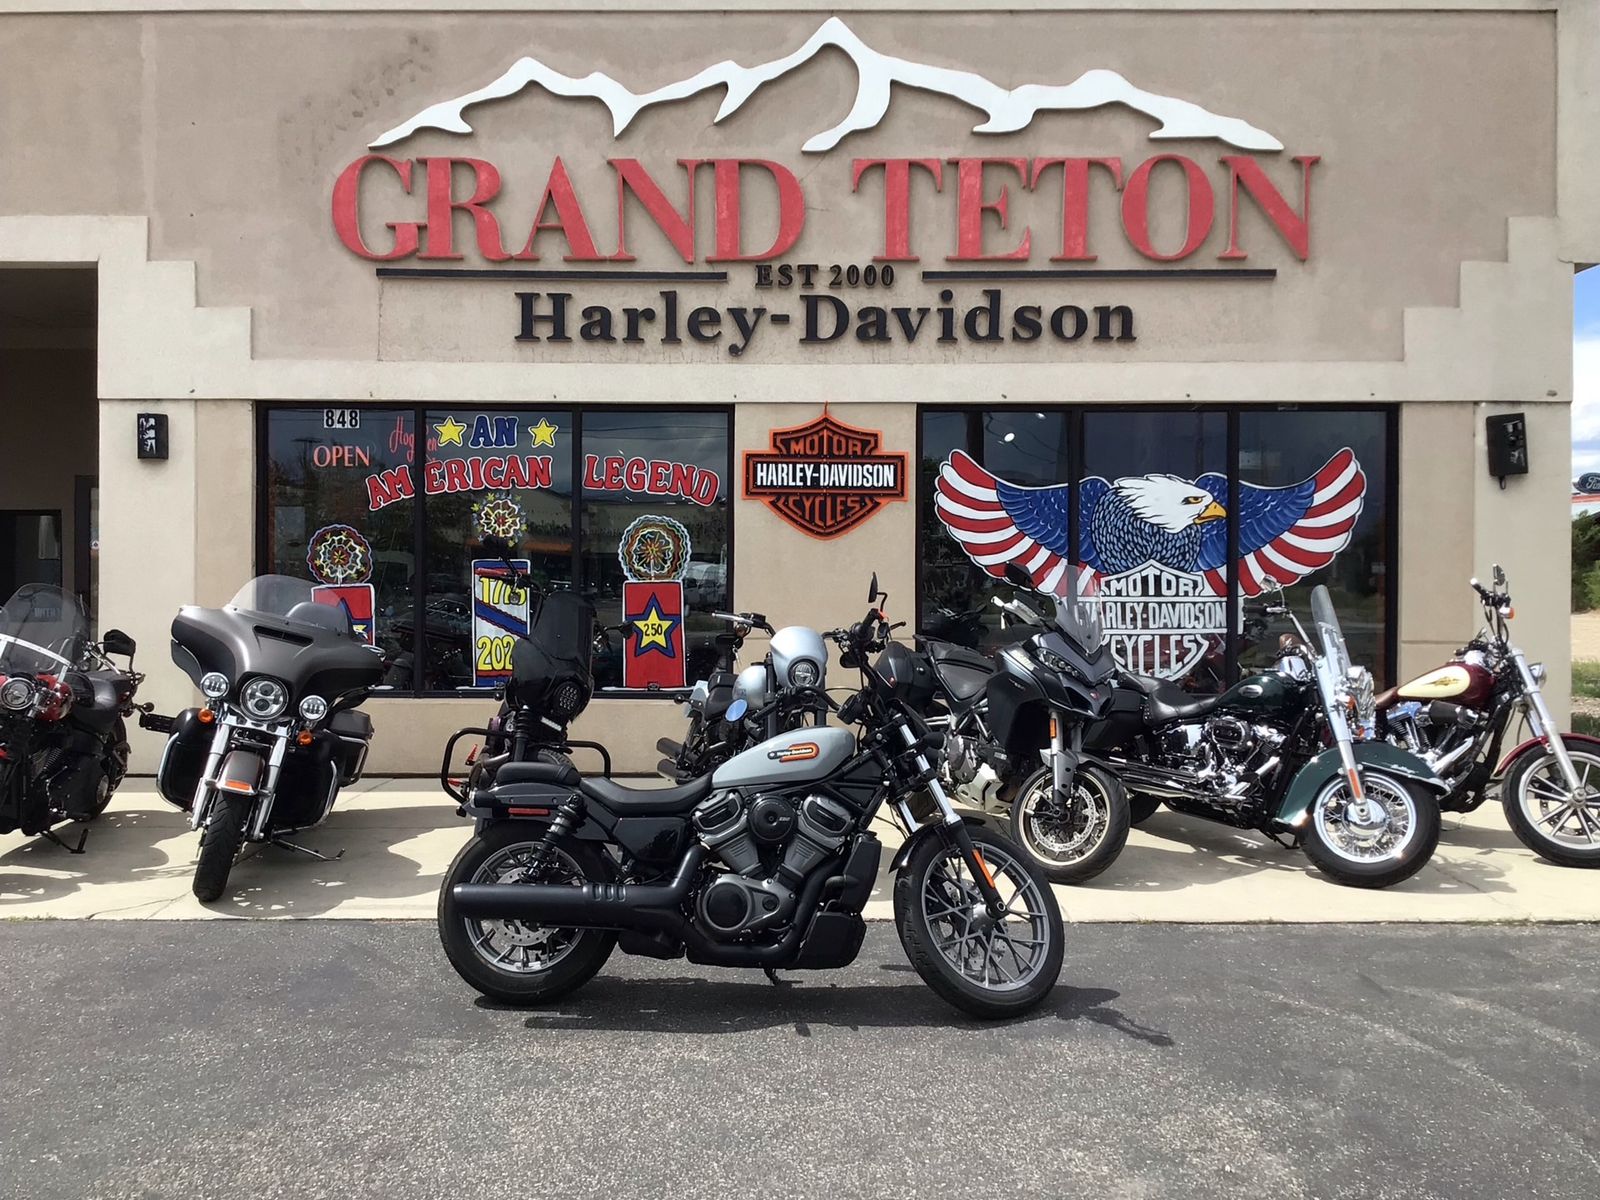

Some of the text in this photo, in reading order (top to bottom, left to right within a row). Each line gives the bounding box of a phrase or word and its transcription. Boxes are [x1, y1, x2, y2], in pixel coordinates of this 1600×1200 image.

[331, 153, 1320, 264] GRAND TETON
[755, 264, 895, 289] EST 2000
[514, 289, 1136, 357] Harley-Davidson
[325, 409, 359, 428] 848
[468, 414, 519, 449] AN
[313, 446, 370, 467] OPEN
[790, 430, 862, 455] MOTOR
[582, 454, 720, 507] LEGEND
[756, 462, 895, 488] HARLEY-DAVIDSON
[788, 495, 862, 527] CYCLES
[1110, 566, 1194, 597] MOTOR
[643, 623, 663, 637] 250
[1110, 634, 1197, 677] CYCLES
